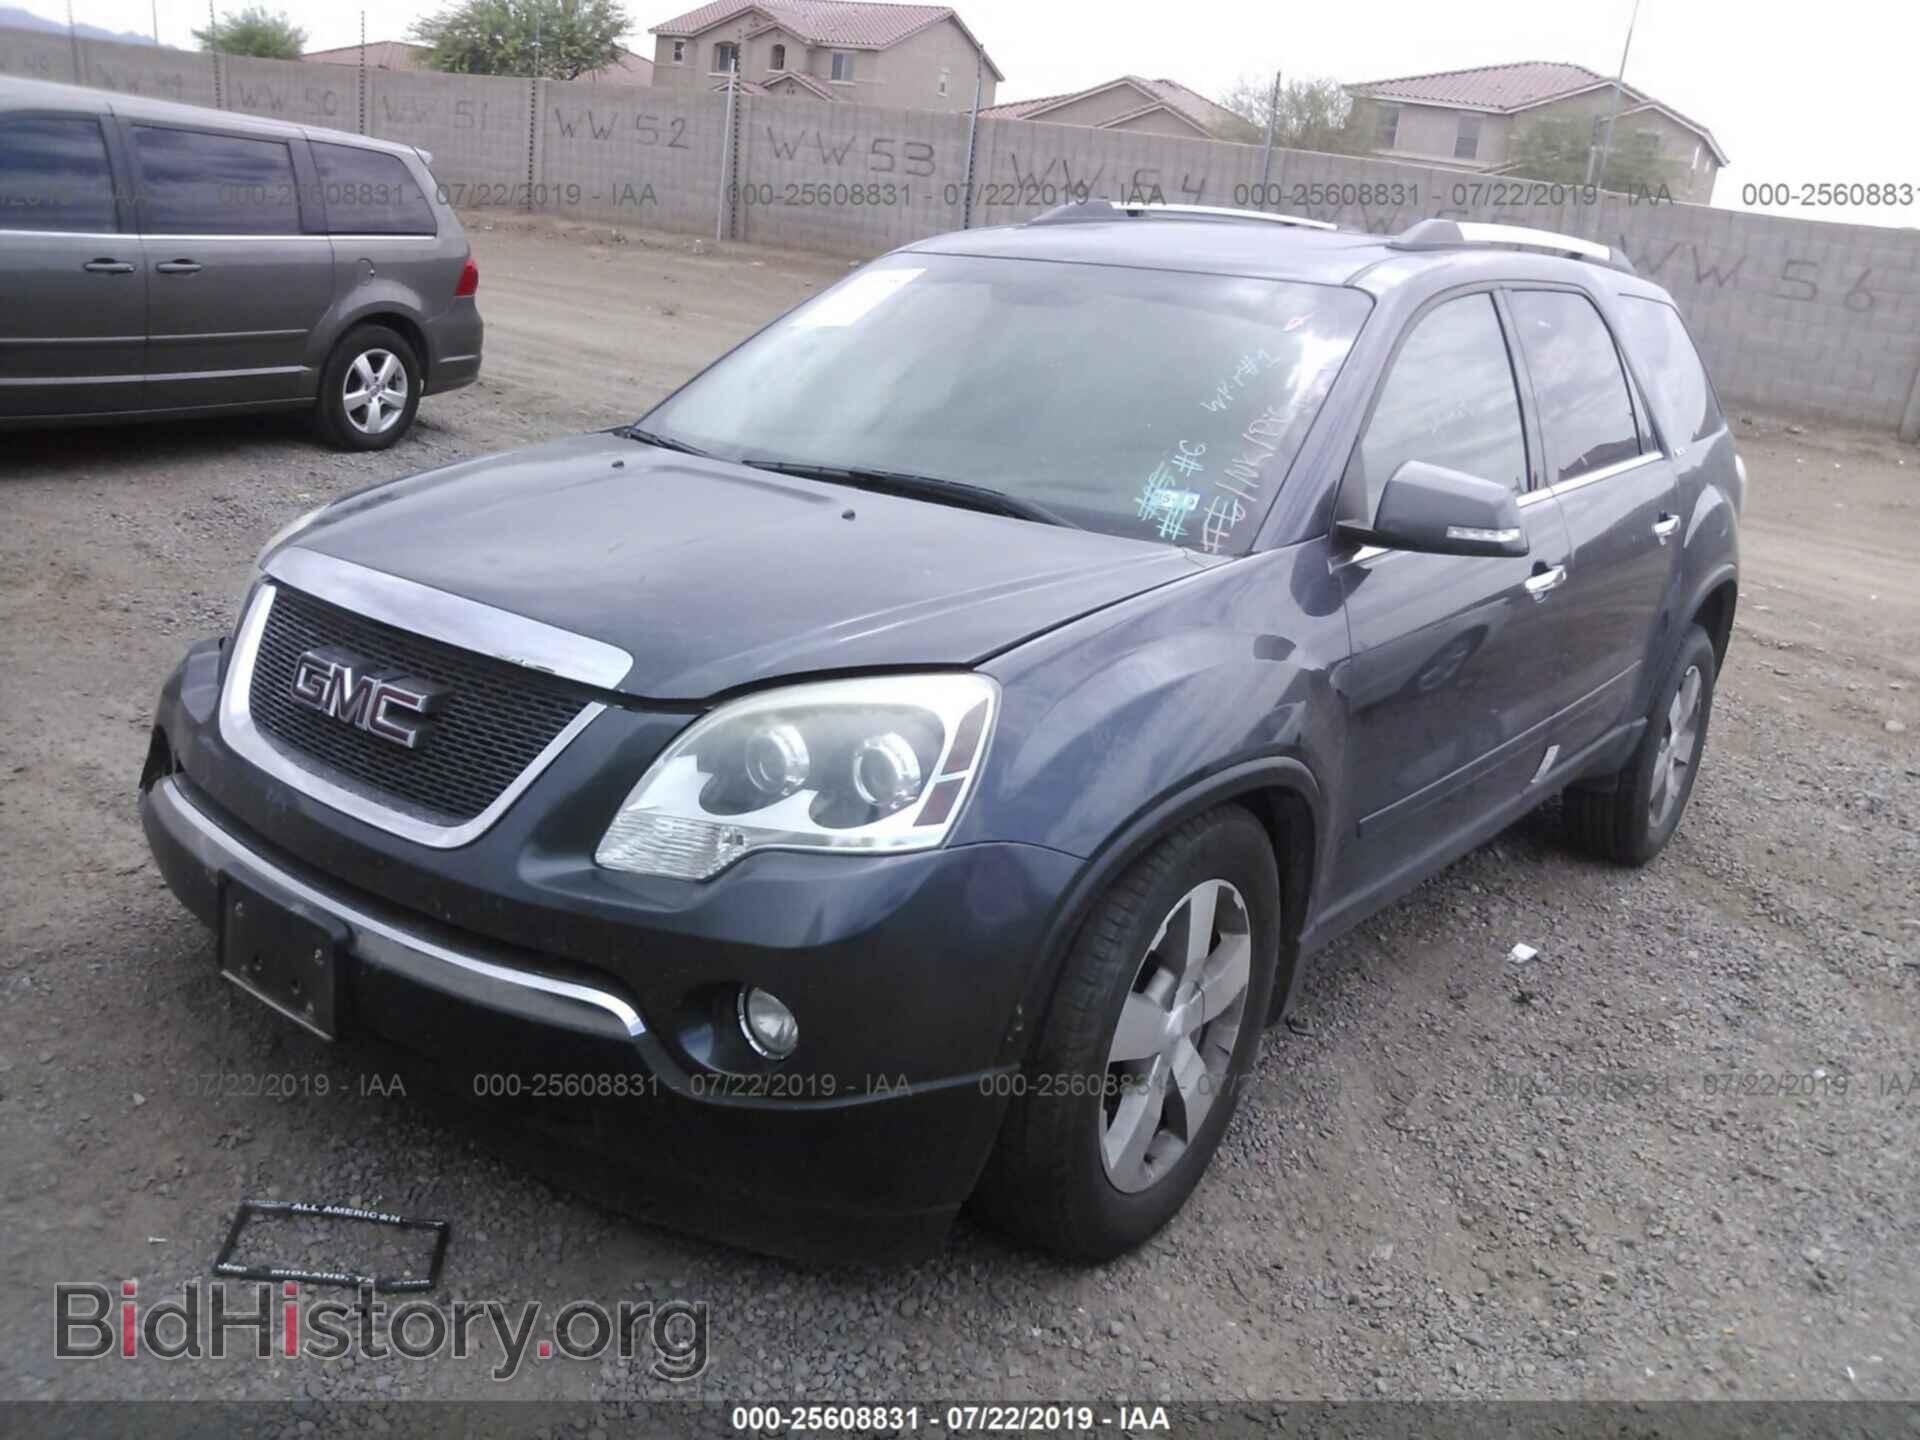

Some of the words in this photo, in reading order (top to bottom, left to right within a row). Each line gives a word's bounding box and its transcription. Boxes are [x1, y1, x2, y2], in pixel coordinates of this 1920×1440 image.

[634, 112, 691, 150] 52
[868, 137, 937, 178] 53
[288, 648, 432, 749] GMC
[291, 1202, 319, 1213] ALL
